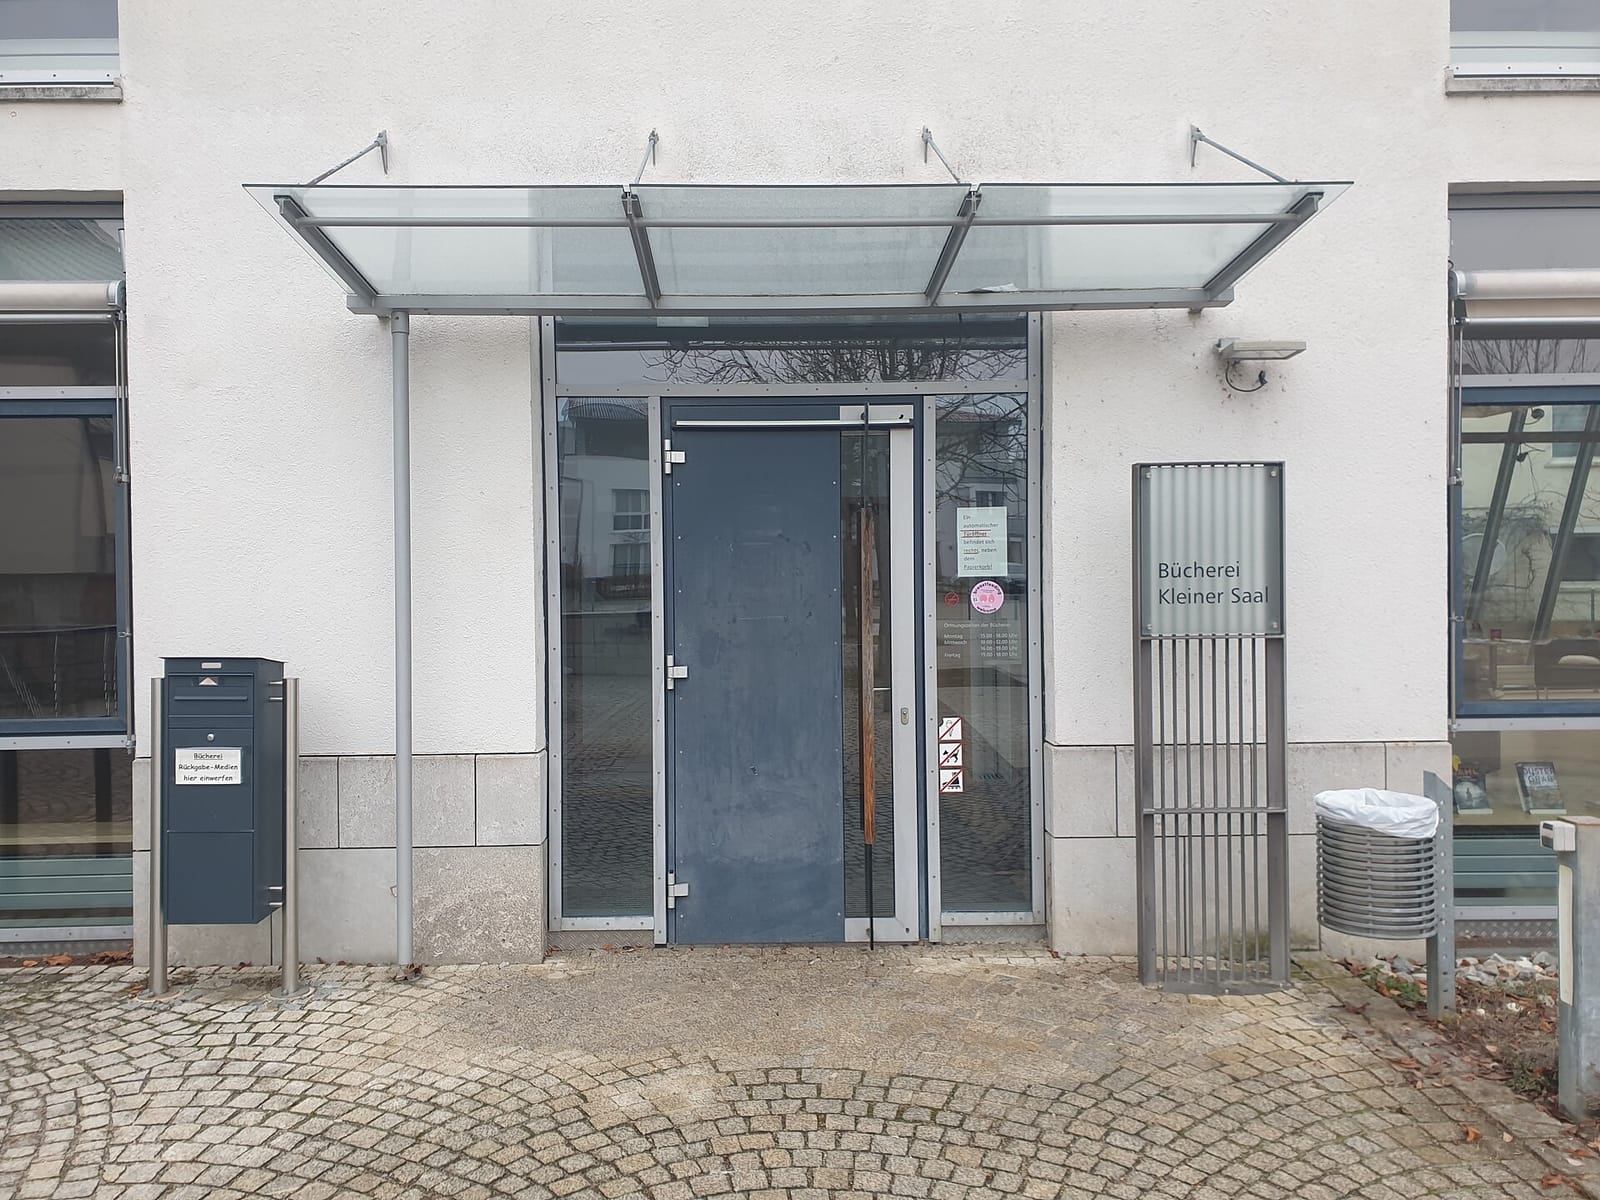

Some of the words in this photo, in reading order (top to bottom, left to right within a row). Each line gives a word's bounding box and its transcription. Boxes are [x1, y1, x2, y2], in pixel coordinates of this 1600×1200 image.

[1158, 561, 1240, 578] Bücherei
[1159, 587, 1224, 605] Kleiner
[1231, 586, 1269, 603] Saal
[193, 752, 223, 760] Bücherei
[178, 763, 239, 772] Rückgabe-Medien
